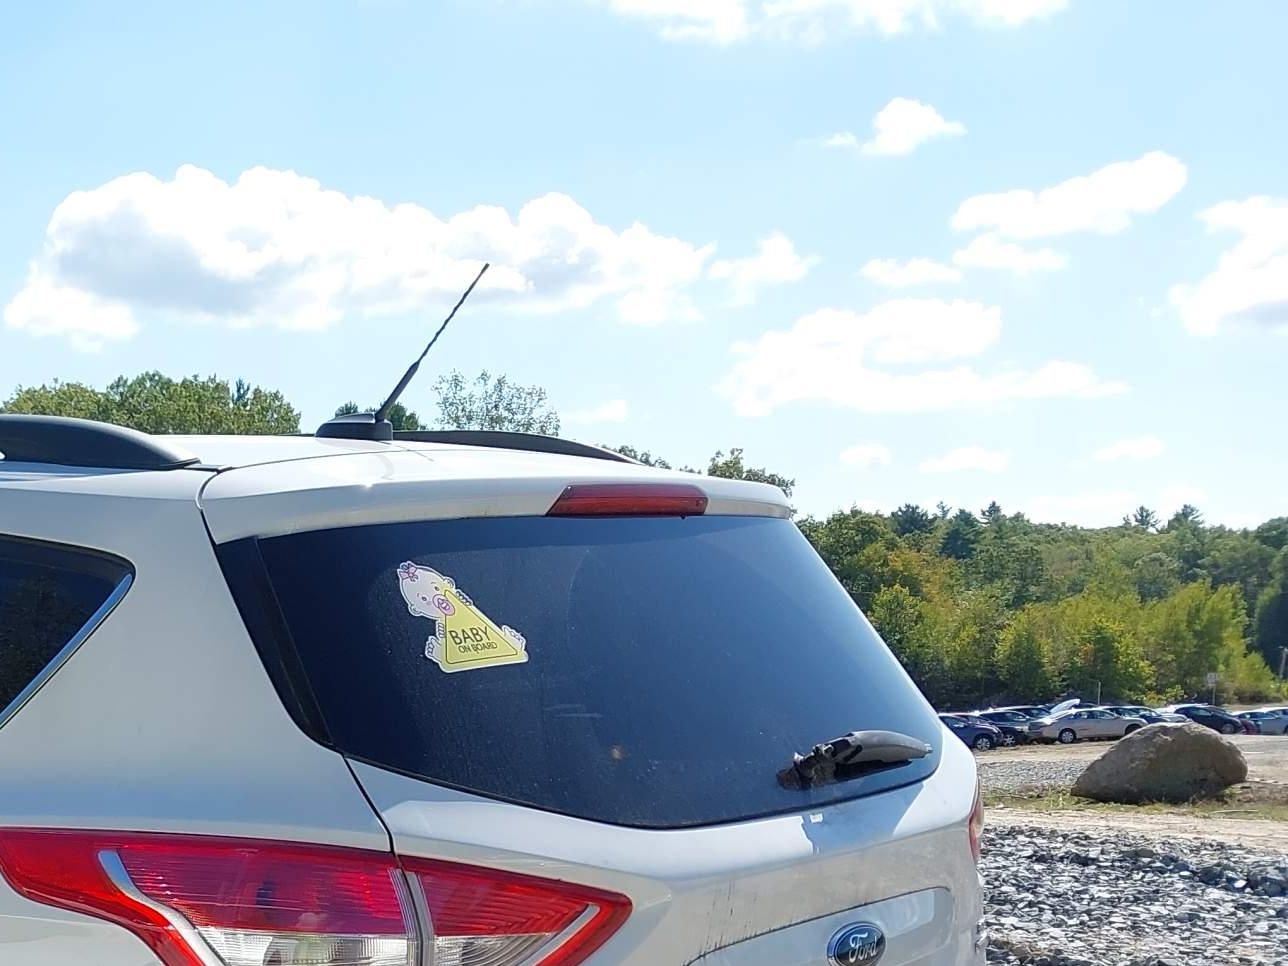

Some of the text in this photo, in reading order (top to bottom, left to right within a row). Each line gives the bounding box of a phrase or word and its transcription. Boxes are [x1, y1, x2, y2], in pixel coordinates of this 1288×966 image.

[448, 625, 491, 646] BABY
[457, 641, 498, 654] ON BOARD
[848, 931, 877, 963] Ford
